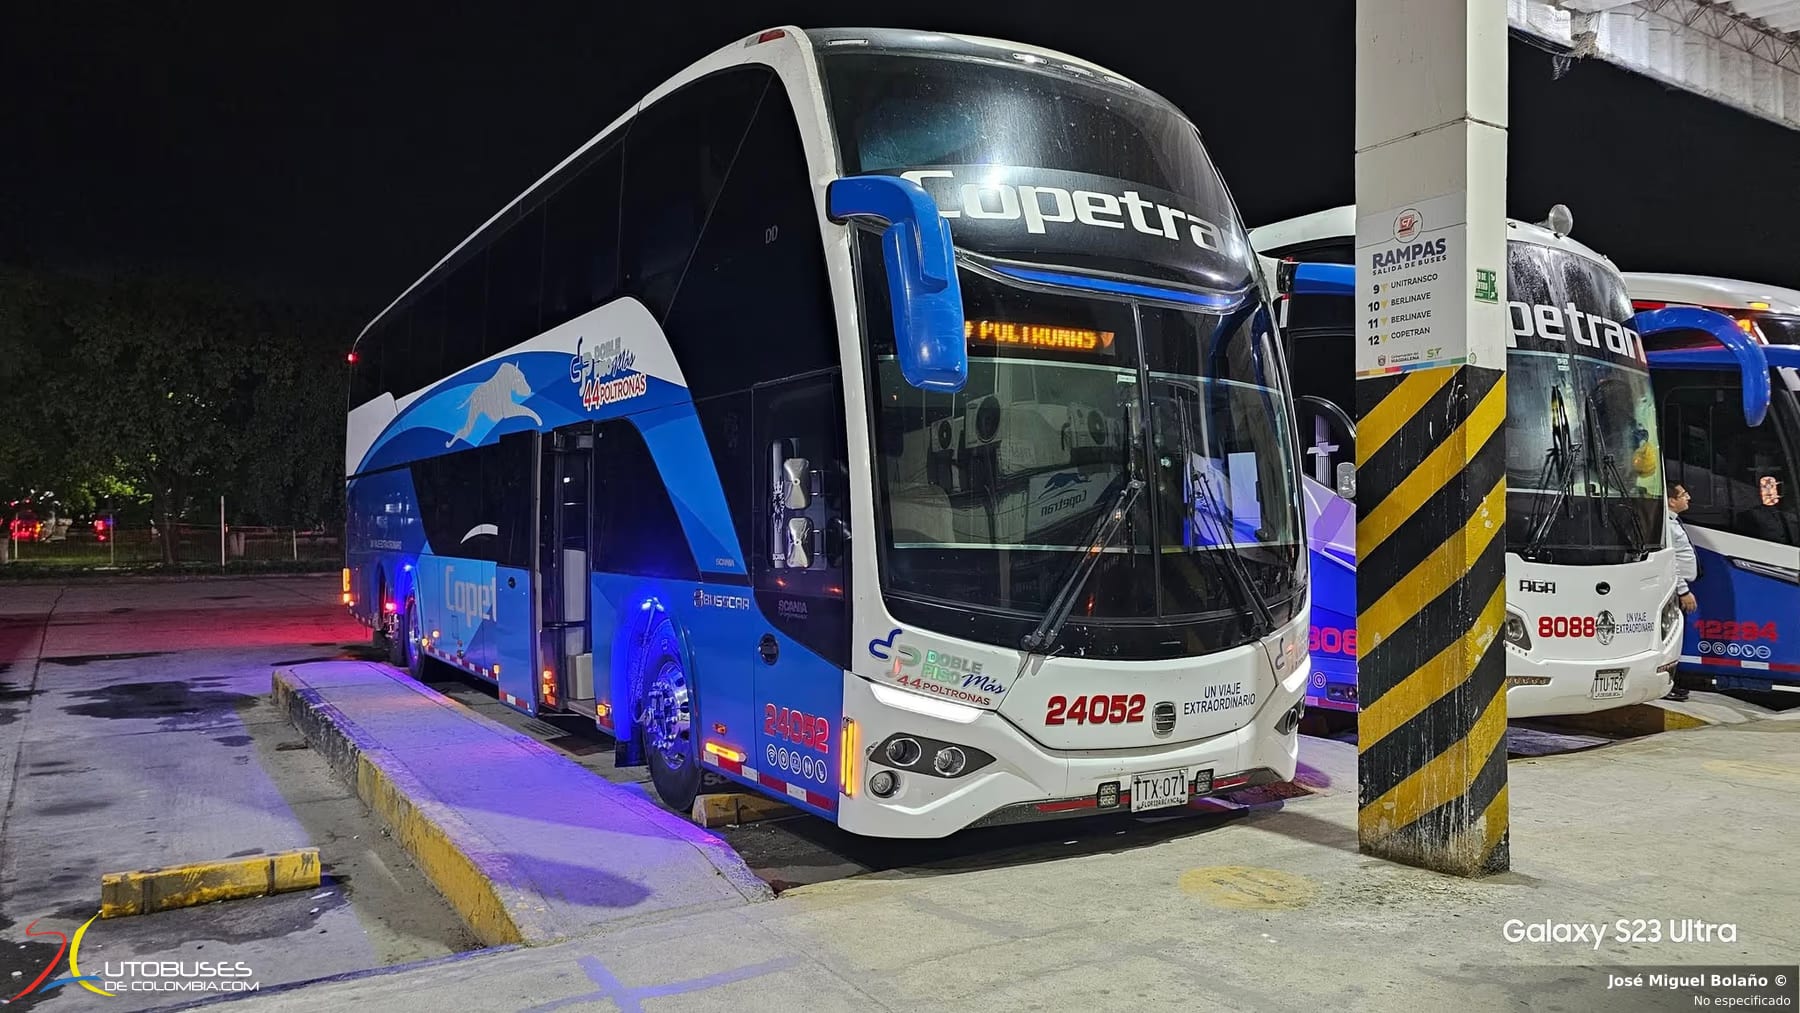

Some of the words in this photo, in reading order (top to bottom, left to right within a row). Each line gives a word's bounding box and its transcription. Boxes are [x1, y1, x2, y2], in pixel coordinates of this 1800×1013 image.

[900, 169, 1228, 251] Copetra
[765, 225, 778, 244] DD
[1373, 238, 1446, 269] RAMPAS
[1373, 264, 1402, 276] SALIDA
[1404, 261, 1416, 269] DE
[1418, 254, 1447, 266] BUSES
[1373, 284, 1380, 295] 9
[1391, 273, 1438, 288] UNITRANSCO
[1368, 301, 1380, 312] 10
[1391, 292, 1431, 306] BERLINAVE
[1368, 318, 1378, 329] 11
[1391, 310, 1432, 323] BERLINAVE
[1368, 335, 1380, 346] 12
[1391, 327, 1431, 339] COPETRAN
[584, 380, 601, 411] 44
[600, 374, 646, 405] POLTRONAS
[1519, 580, 1556, 594] AGA
[1538, 616, 1596, 638] 8088
[926, 649, 983, 674] DOBLE
[897, 675, 921, 689] 44
[922, 682, 991, 706] POLTRONAS
[961, 672, 1006, 694] Más
[1204, 686, 1217, 699] UN
[1218, 682, 1241, 696] VIAJE
[1045, 694, 1147, 727] 24052
[1184, 693, 1256, 715] EXTRAORDINARIO
[764, 703, 829, 754] 24052
